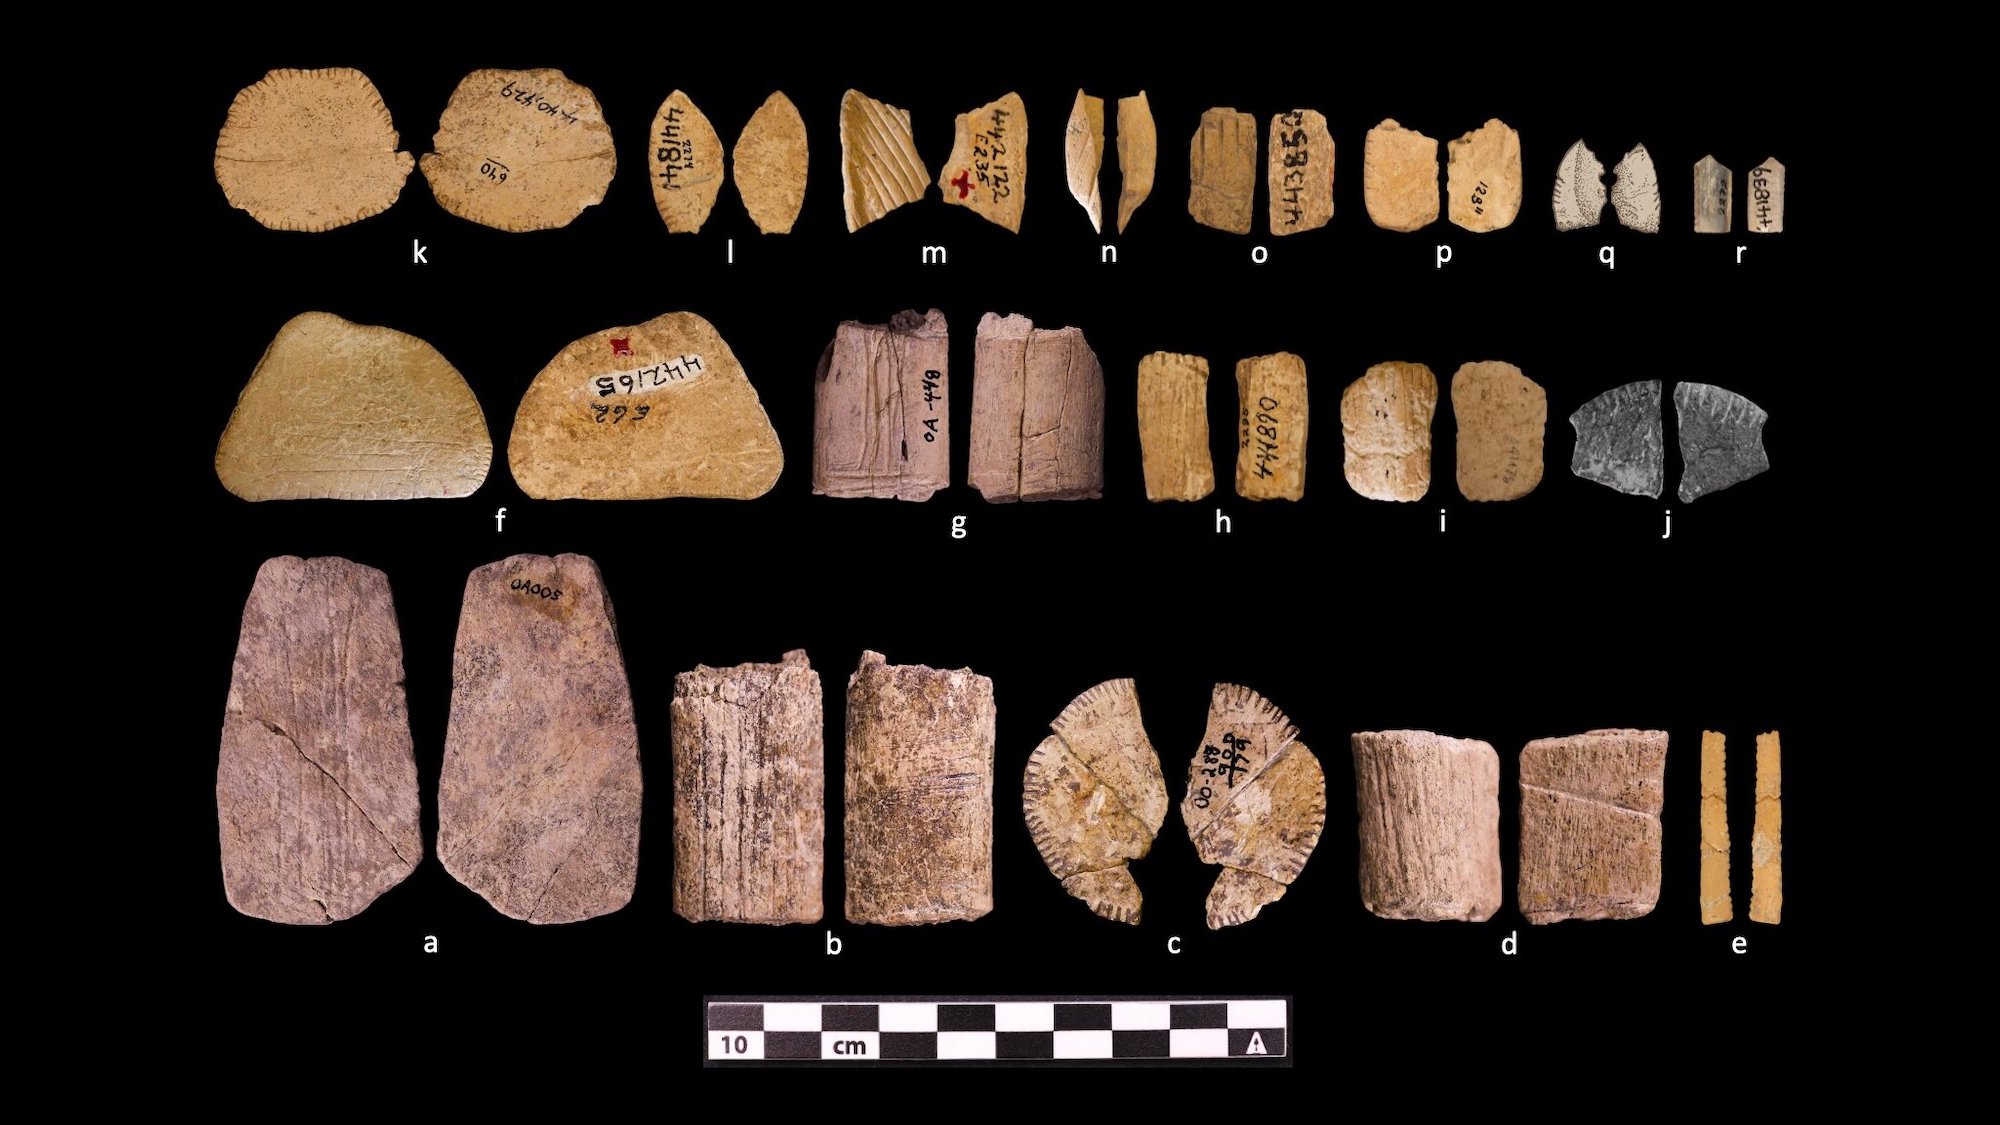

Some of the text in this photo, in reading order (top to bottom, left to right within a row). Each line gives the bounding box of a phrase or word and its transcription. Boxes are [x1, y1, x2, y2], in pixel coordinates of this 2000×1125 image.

[480, 162, 508, 184] 640
[595, 355, 702, 397] 442165
[721, 1036, 867, 1055] 10 cm
